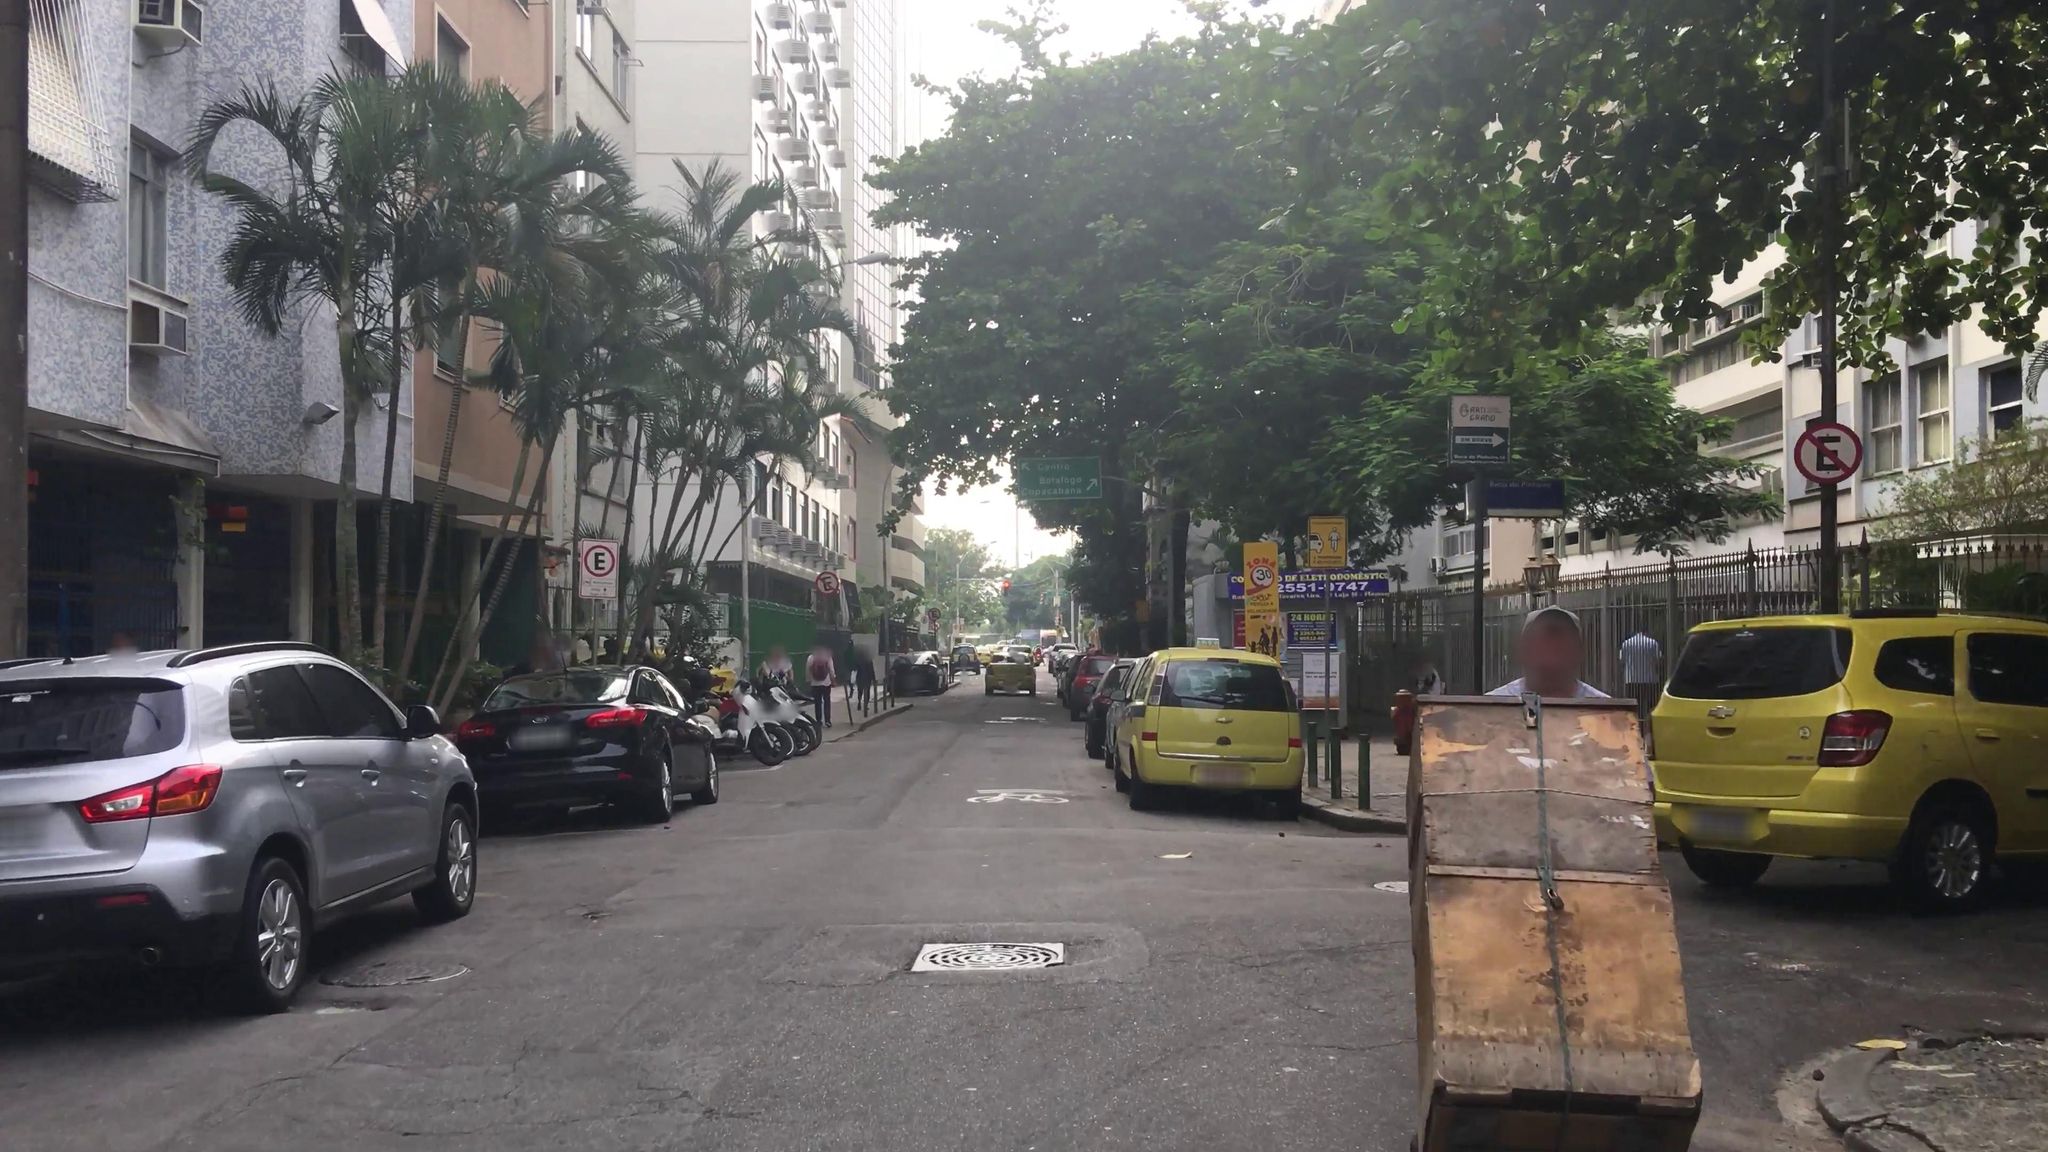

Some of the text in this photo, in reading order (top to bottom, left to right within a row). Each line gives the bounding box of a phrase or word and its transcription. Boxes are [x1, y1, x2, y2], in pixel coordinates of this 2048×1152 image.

[1817, 436, 1841, 471] E
[1038, 463, 1071, 471] Centro
[1040, 476, 1082, 486] Botafogo
[1021, 487, 1082, 497] Copacabana
[594, 552, 606, 571] E
[1246, 557, 1276, 569] ZONA
[1256, 569, 1272, 581] 30
[1285, 574, 1298, 582] DE
[1290, 612, 1335, 621] 24 HORS
